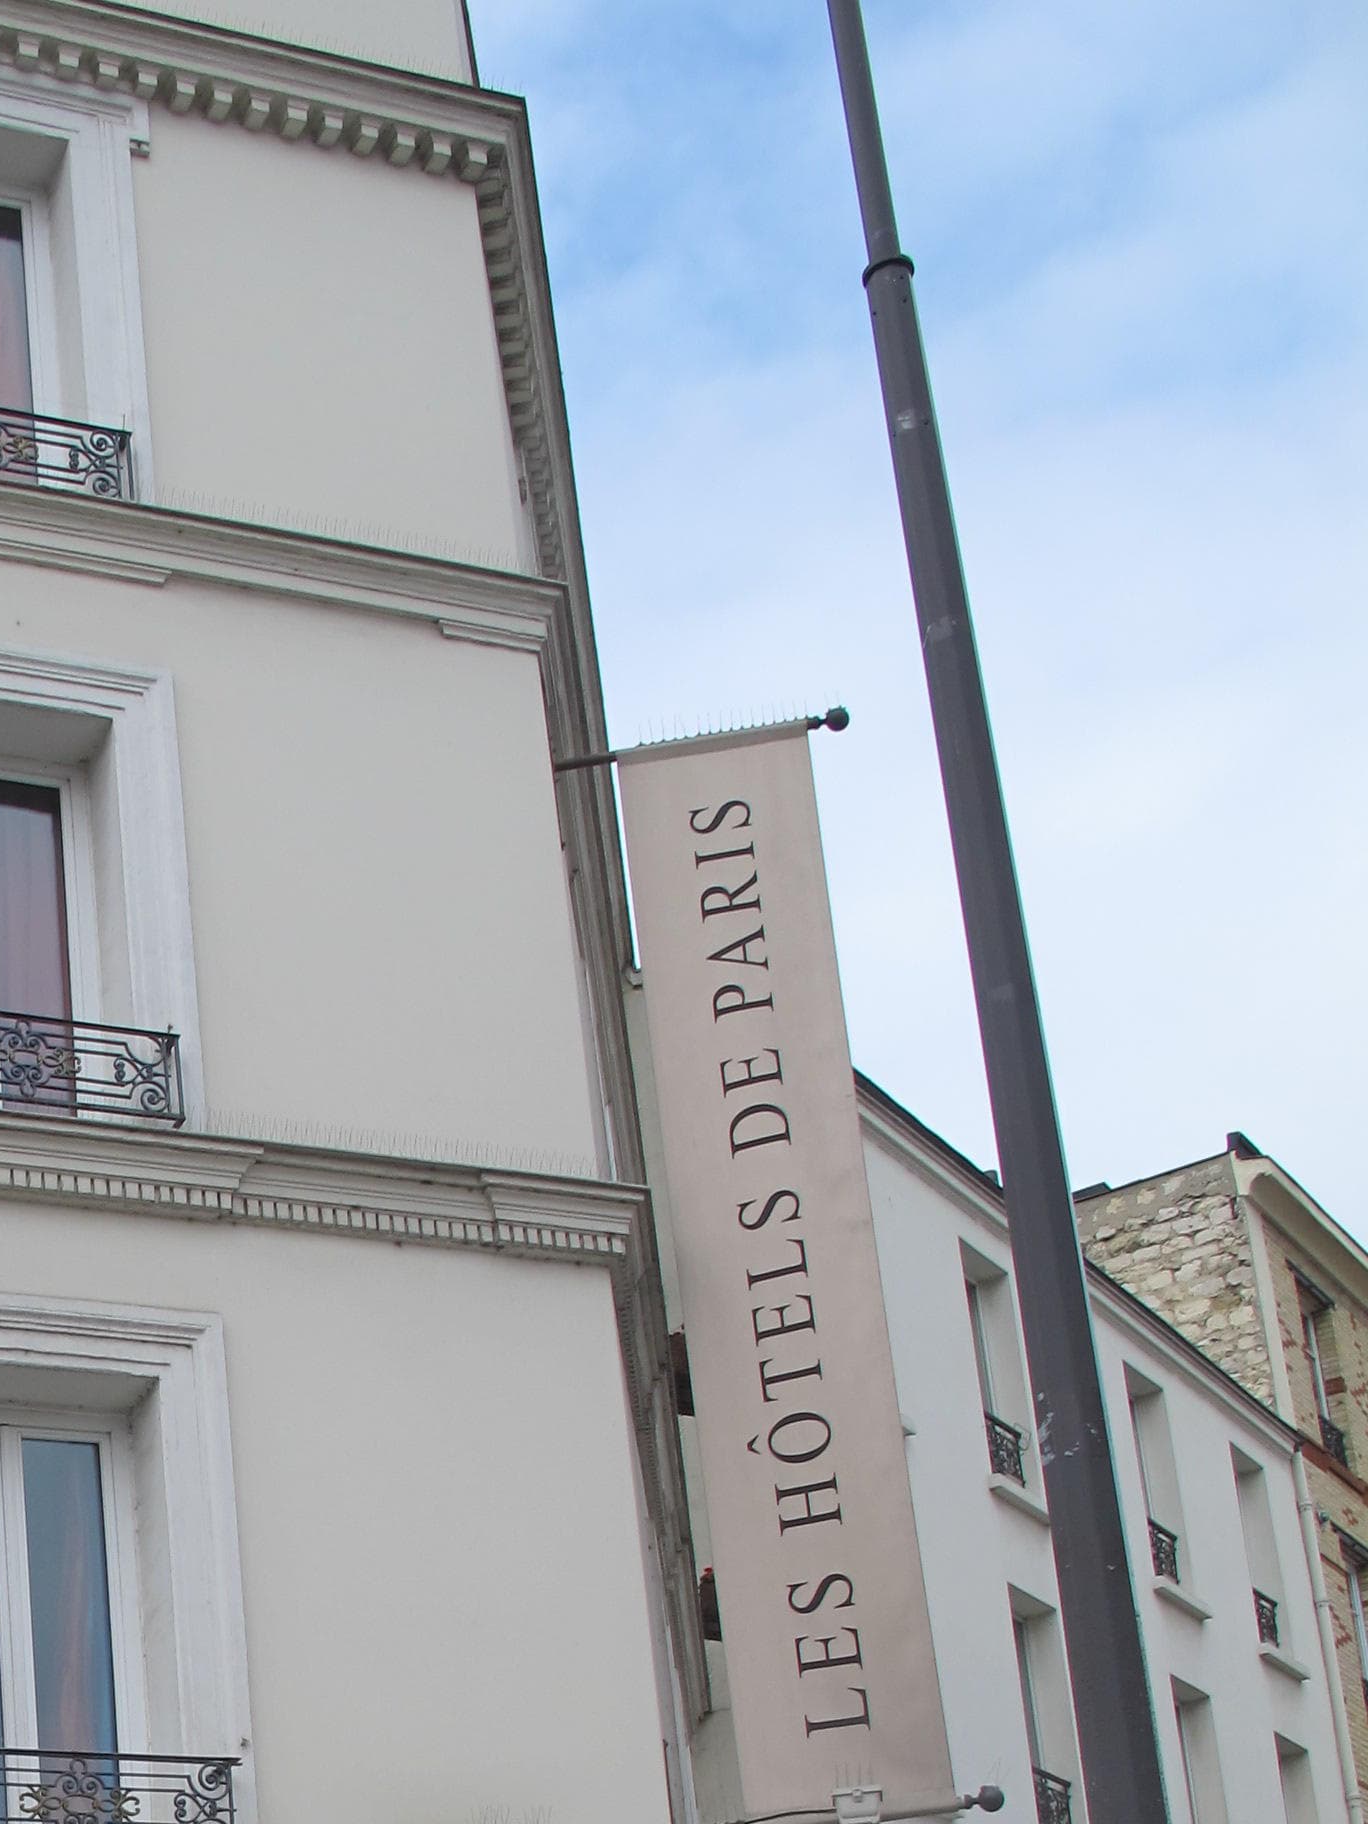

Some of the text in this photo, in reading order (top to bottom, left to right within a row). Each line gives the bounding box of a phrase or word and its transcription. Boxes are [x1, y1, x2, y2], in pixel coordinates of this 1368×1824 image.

[688, 799, 871, 1739] LES HÔTELS DE PARIS
